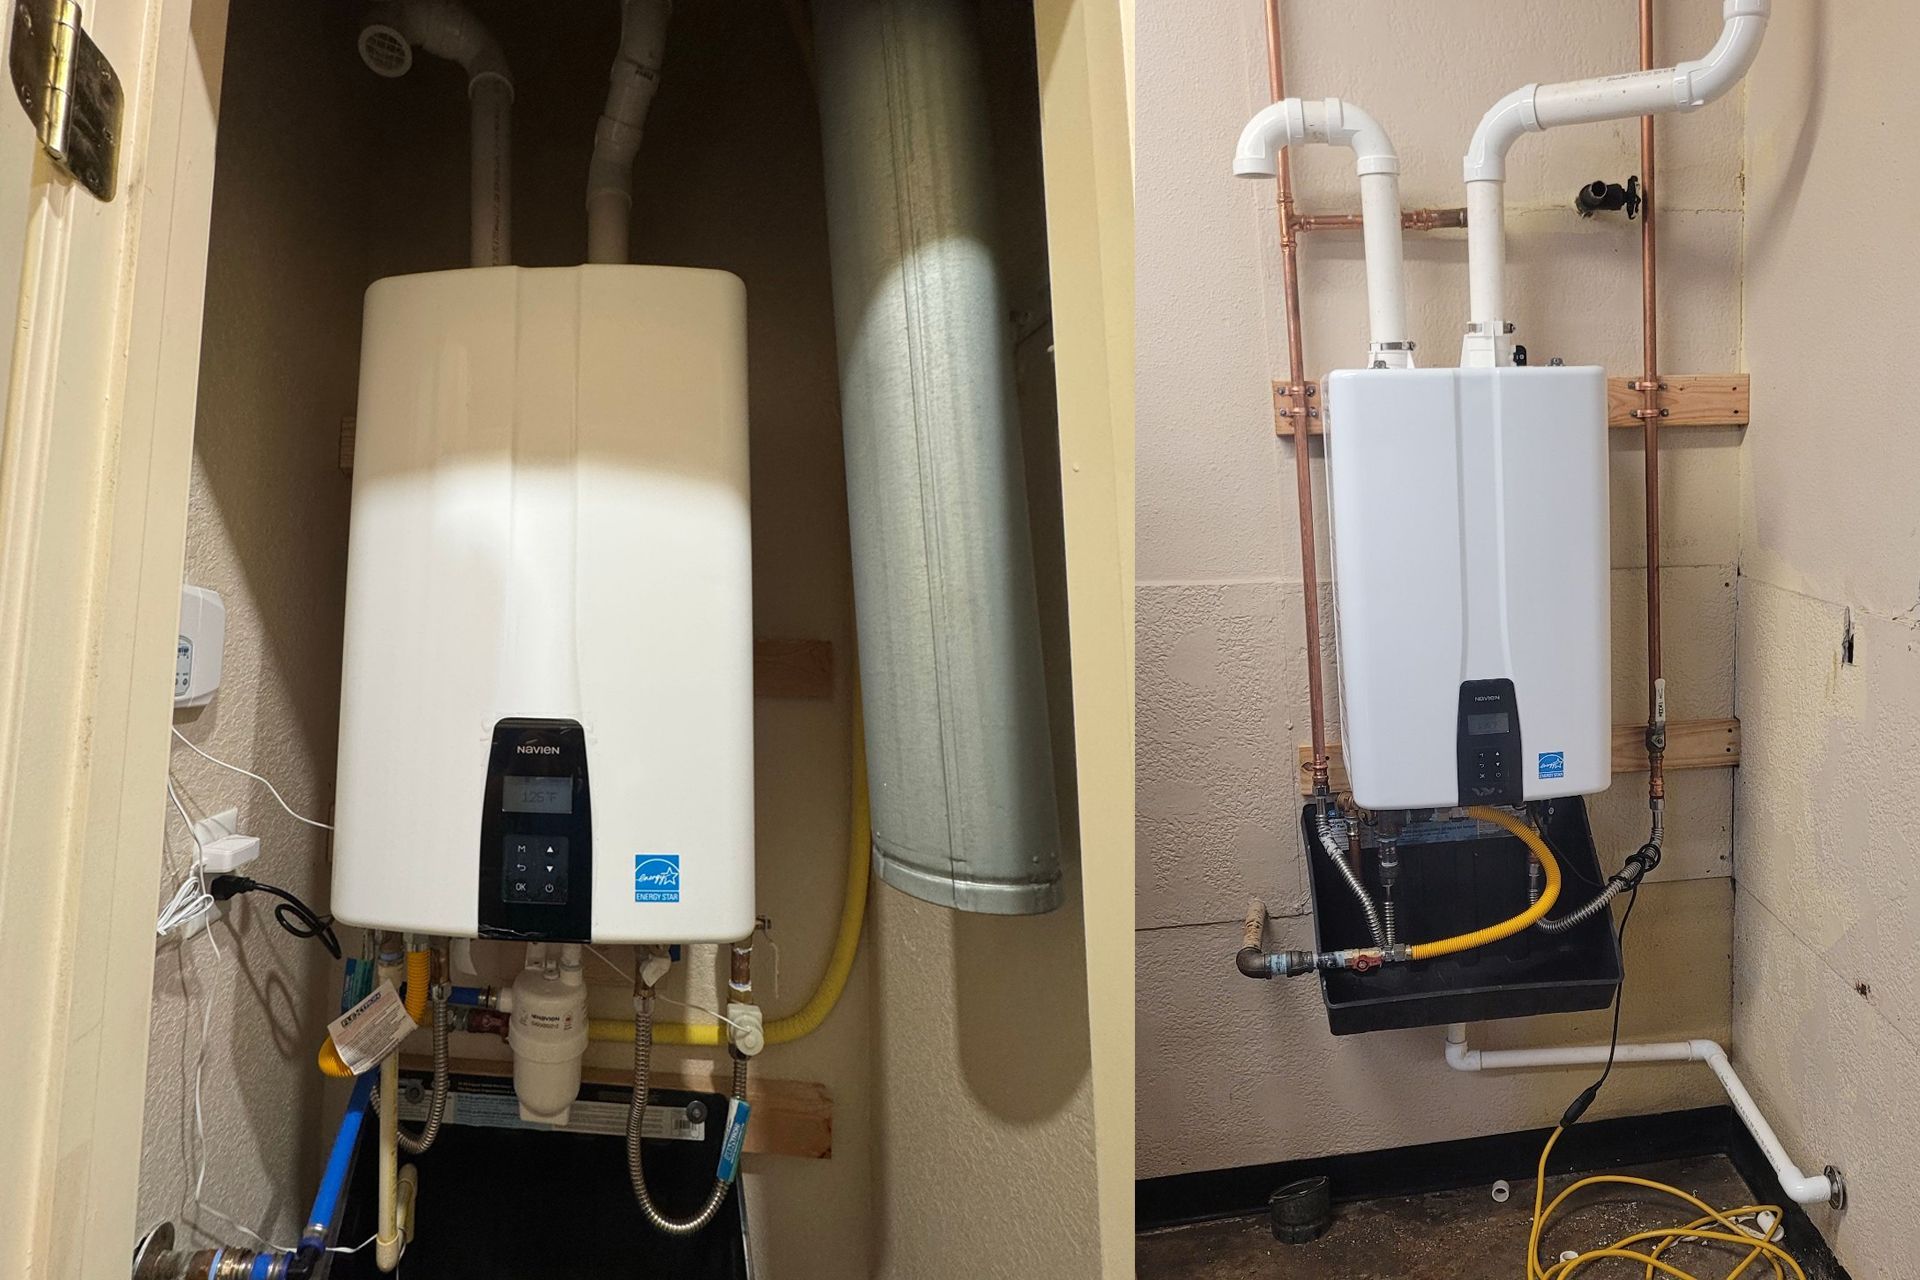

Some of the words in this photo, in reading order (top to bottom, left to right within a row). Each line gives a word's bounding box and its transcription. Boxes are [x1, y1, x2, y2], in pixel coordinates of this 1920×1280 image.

[518, 845, 526, 853] M
[515, 882, 527, 891] OK
[636, 893, 660, 901] ENERGY
[661, 893, 678, 901] STAR
